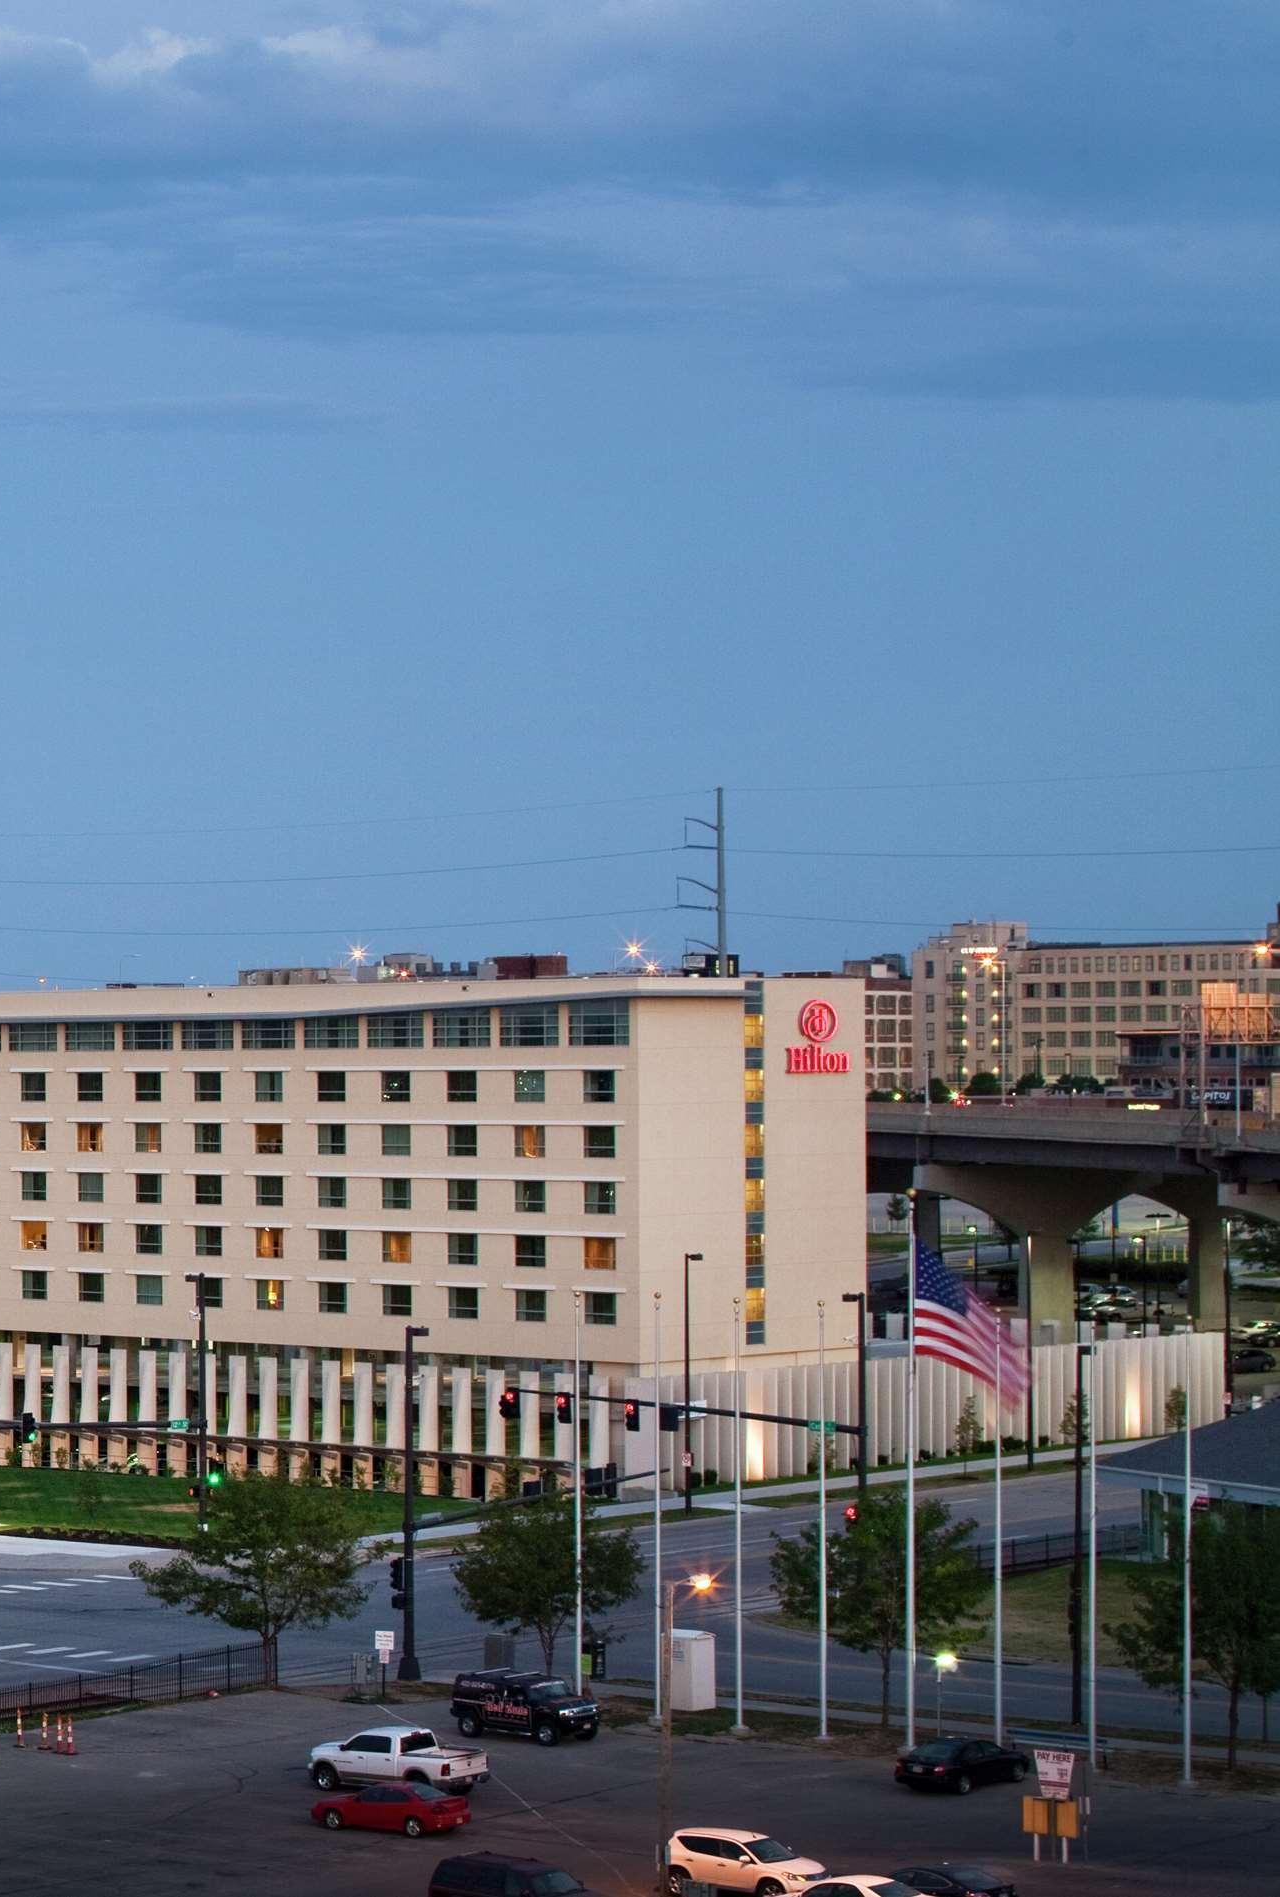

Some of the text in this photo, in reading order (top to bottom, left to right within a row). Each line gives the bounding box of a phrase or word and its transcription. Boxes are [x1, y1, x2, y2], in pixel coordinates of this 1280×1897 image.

[787, 1043, 852, 1073] Hilton
[1036, 1751, 1072, 1762] PAY HERE
